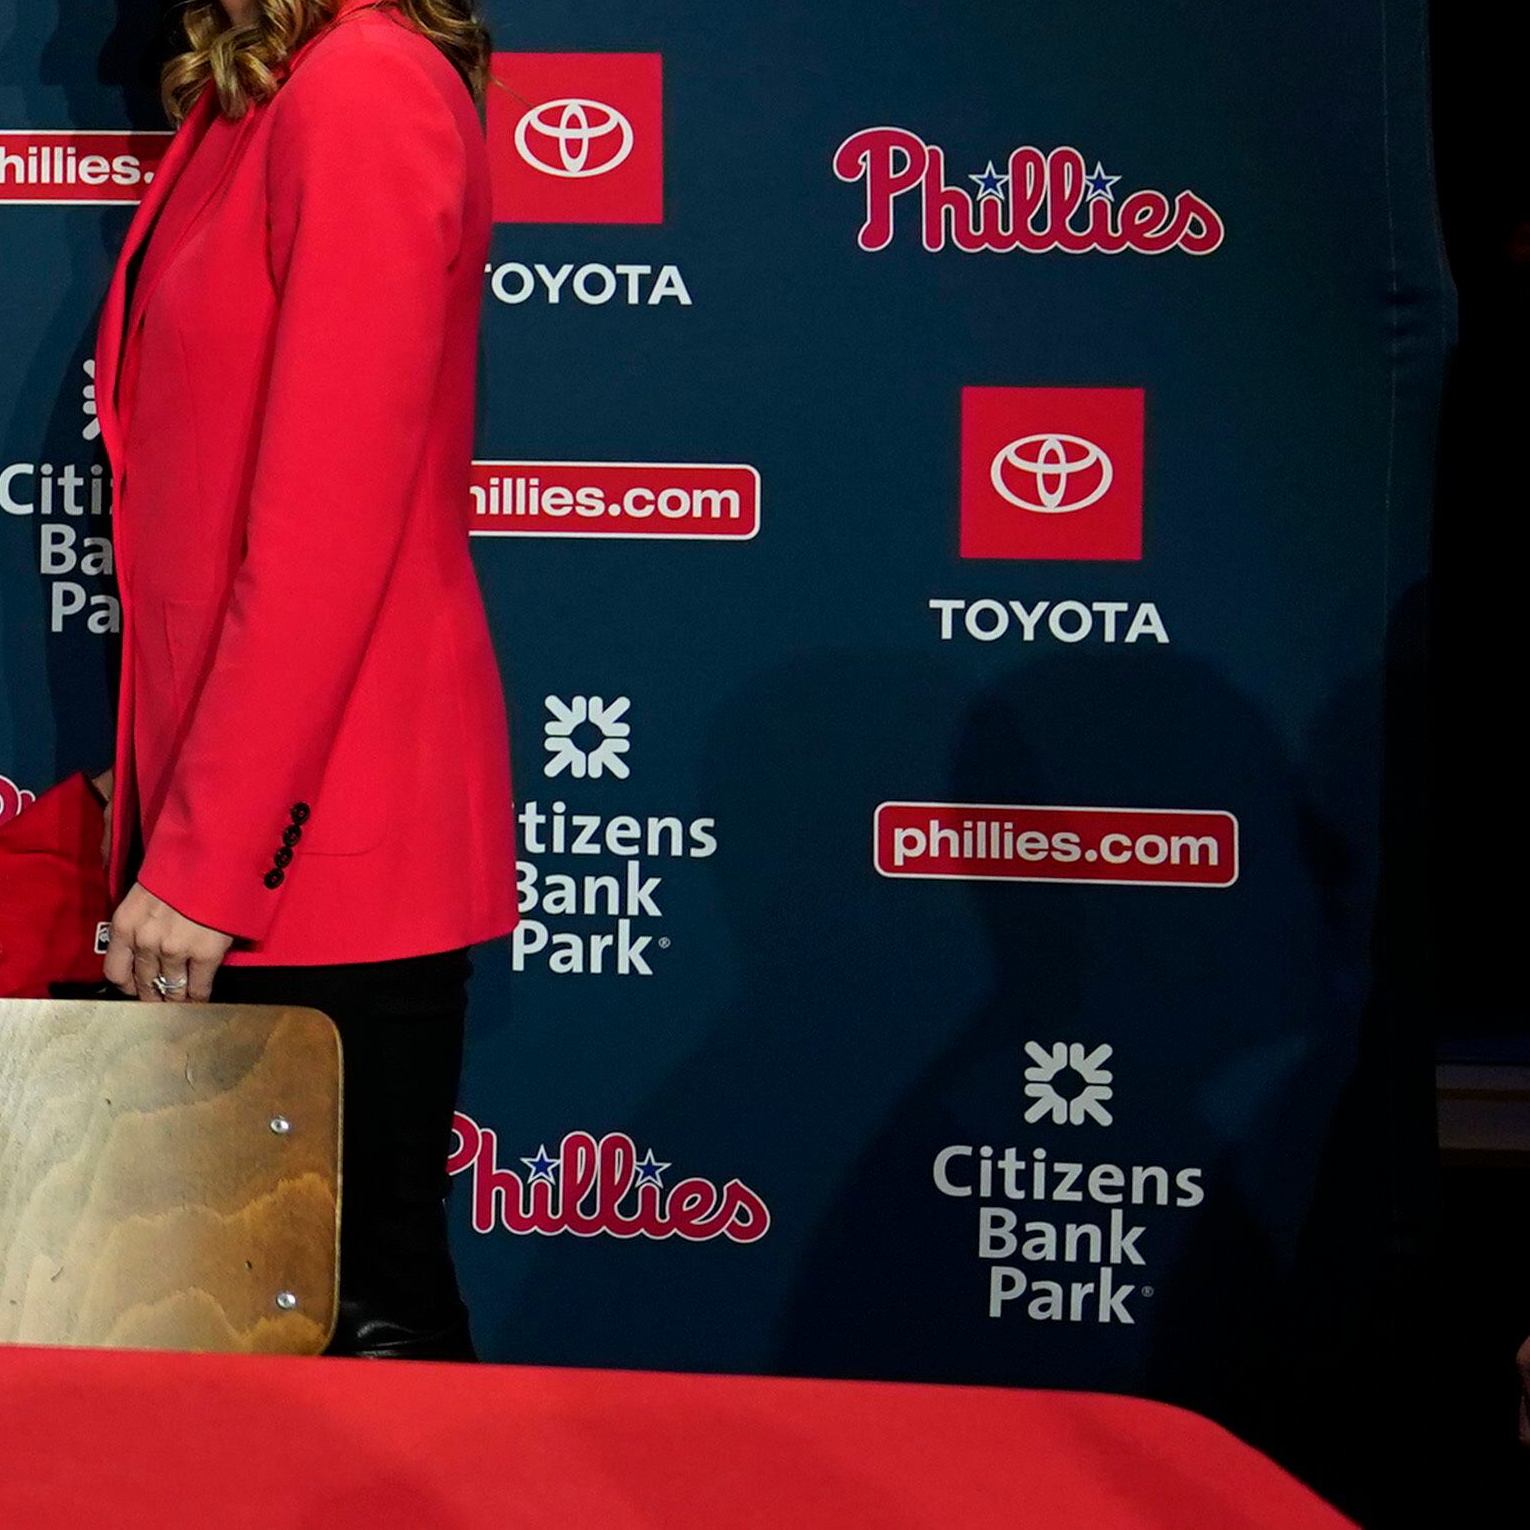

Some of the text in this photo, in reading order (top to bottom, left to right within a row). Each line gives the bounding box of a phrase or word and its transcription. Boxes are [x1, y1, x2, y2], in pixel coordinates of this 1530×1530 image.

[833, 126, 1224, 255] Phillies
[484, 260, 694, 306] OYOTA
[39, 523, 114, 577] Ba
[50, 580, 121, 635] Pa
[929, 599, 1169, 643] TOYOTA
[512, 800, 718, 859] tizens
[894, 820, 1218, 866] phillies.com
[511, 918, 654, 976] Park
[933, 1145, 1205, 1209] Citizens
[979, 1206, 1147, 1268] Bank
[990, 1266, 1135, 1324] Park
